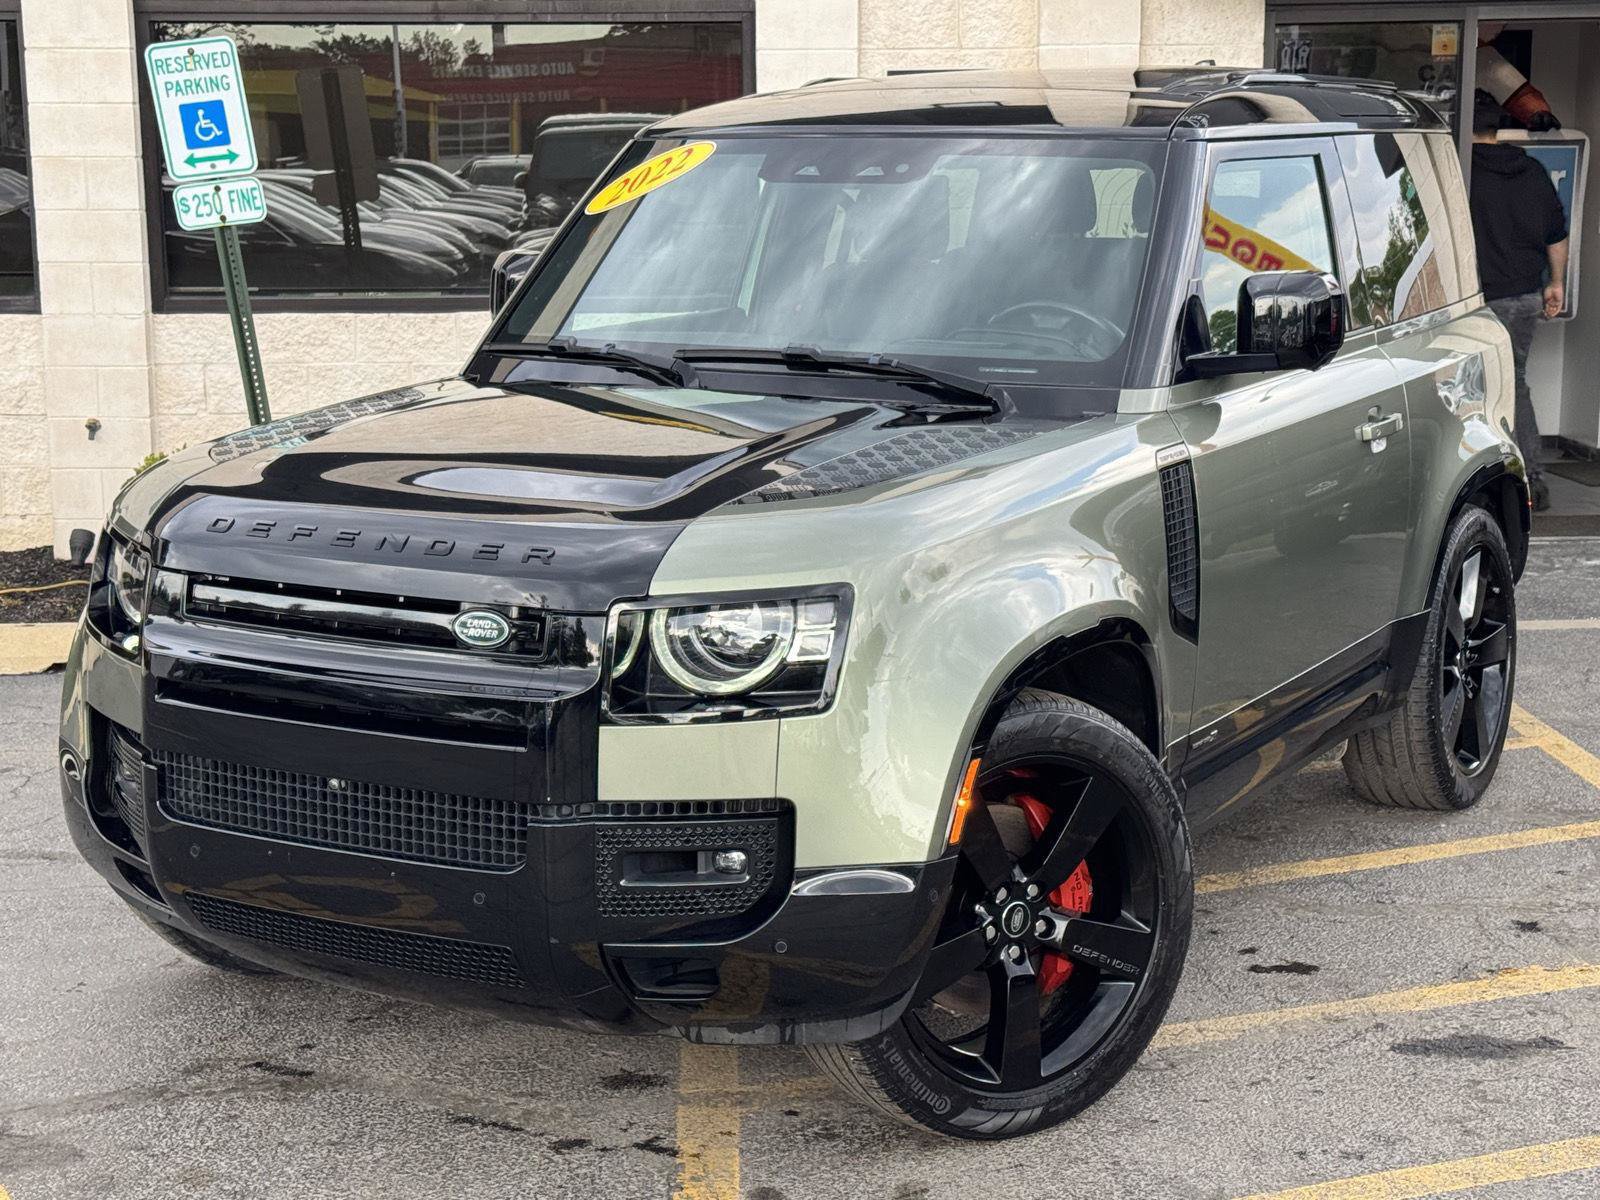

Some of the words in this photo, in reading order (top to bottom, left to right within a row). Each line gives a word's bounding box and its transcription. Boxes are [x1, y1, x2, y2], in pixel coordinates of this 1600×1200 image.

[154, 51, 231, 76] RESERVED
[164, 75, 231, 98] PARKING
[603, 147, 694, 207] 2022
[179, 190, 224, 218] $250
[227, 186, 263, 214] FINE
[205, 517, 557, 566] DEFENDER
[466, 618, 492, 629] LAND
[467, 628, 499, 639] ROVER
[1072, 944, 1141, 975] DEFENDER
[882, 1046, 952, 1115] Continental
